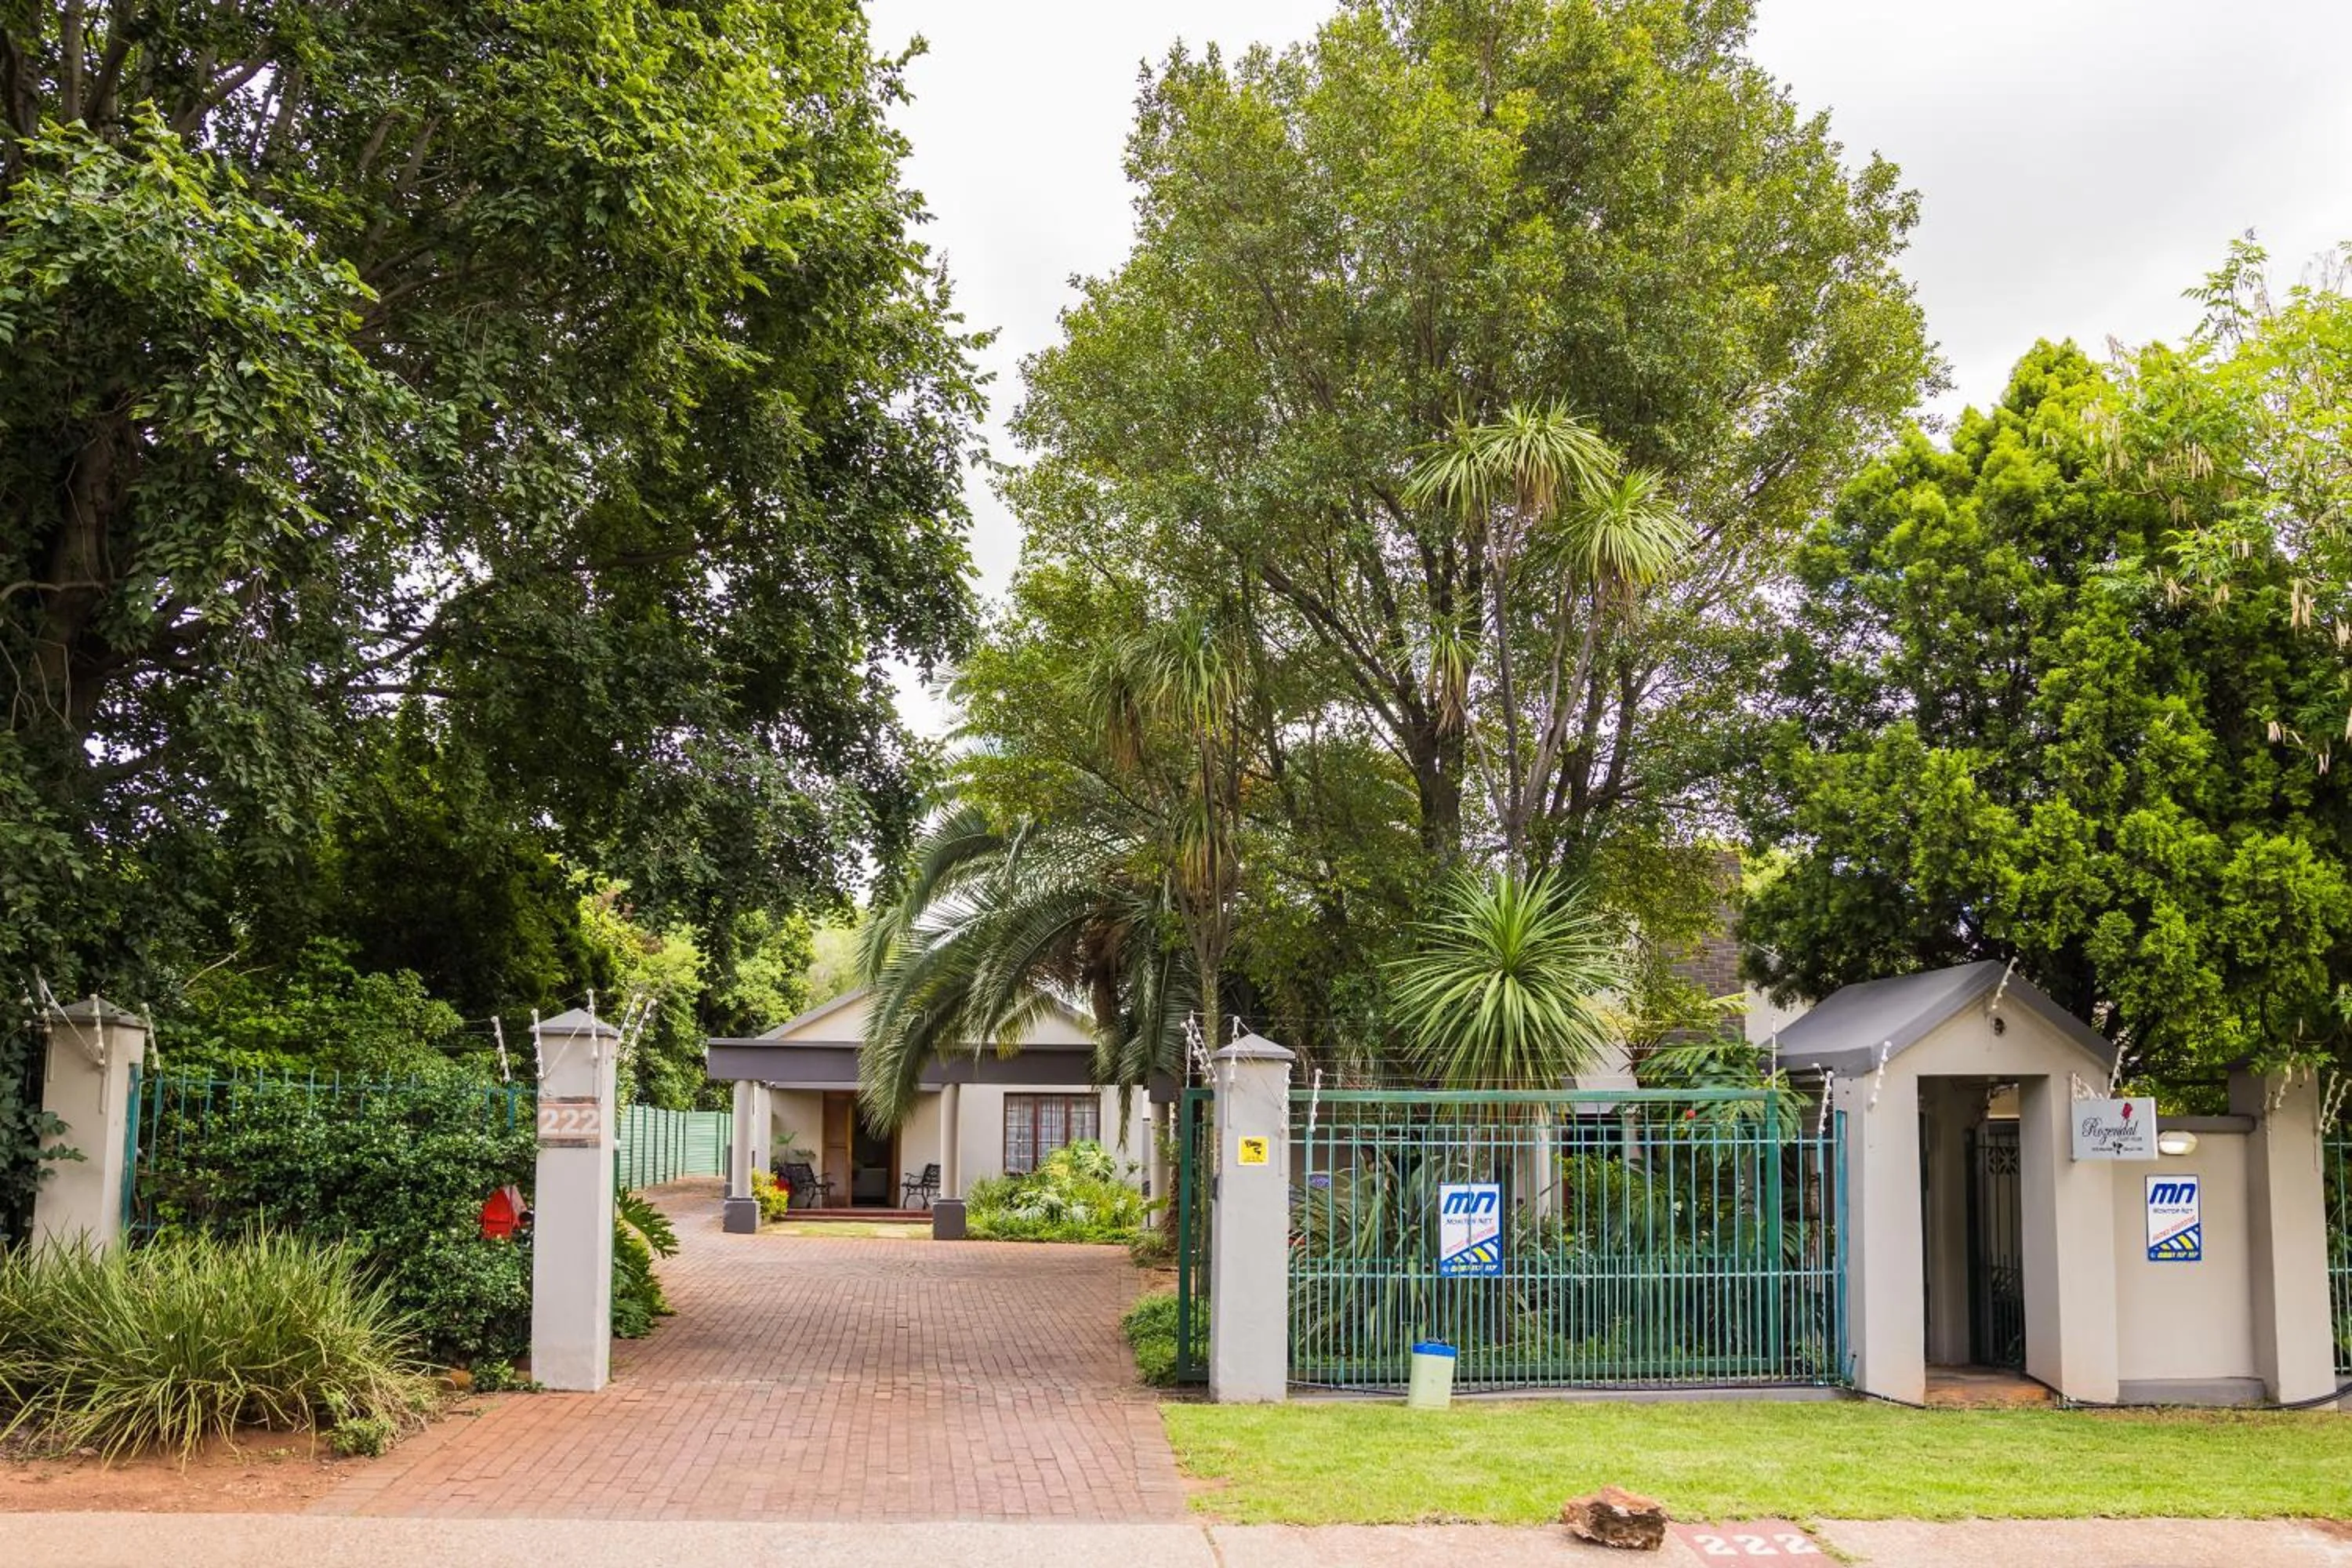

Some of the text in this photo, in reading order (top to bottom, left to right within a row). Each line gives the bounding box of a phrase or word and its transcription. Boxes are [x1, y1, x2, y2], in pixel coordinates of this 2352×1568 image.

[539, 1108, 599, 1134] 222
[2082, 1117, 2139, 1145] Rozendal
[1693, 1534, 1822, 1555] 222
